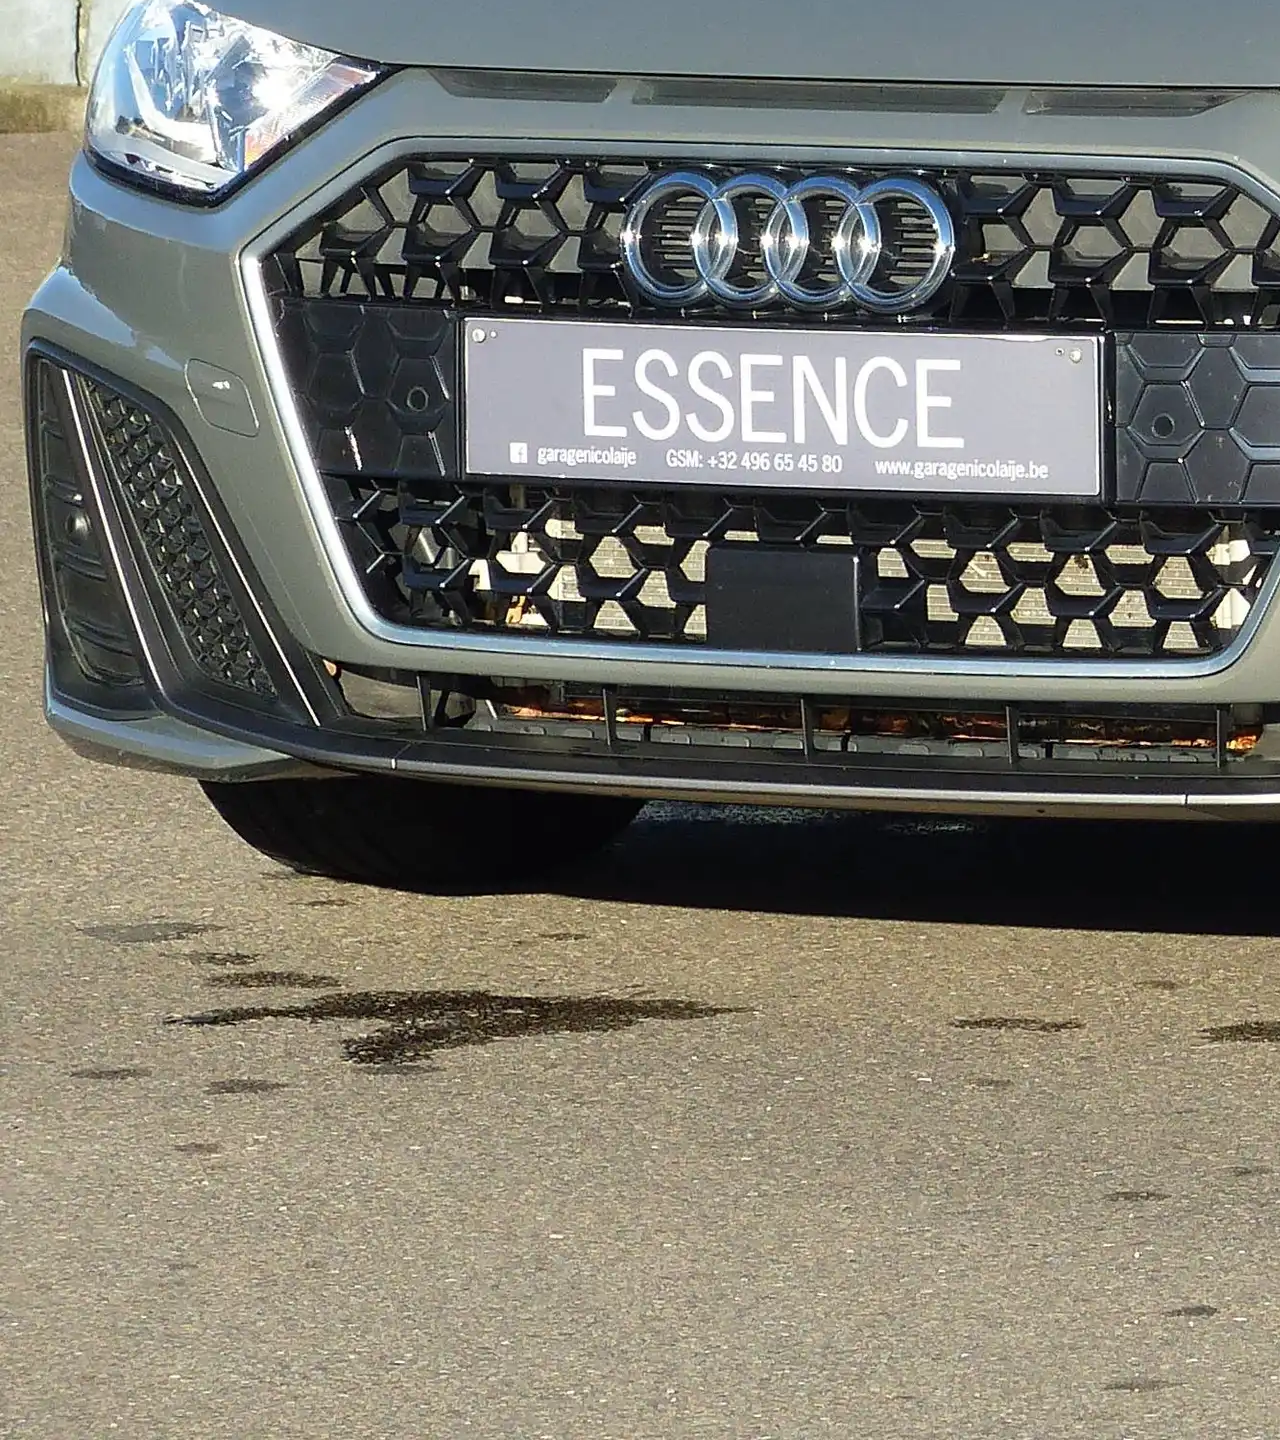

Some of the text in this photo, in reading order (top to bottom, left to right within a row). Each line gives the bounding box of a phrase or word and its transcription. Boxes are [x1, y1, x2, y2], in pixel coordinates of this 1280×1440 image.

[582, 348, 965, 449] ESSENCE
[665, 448, 844, 473] GSM: +32 496 65 45 80
